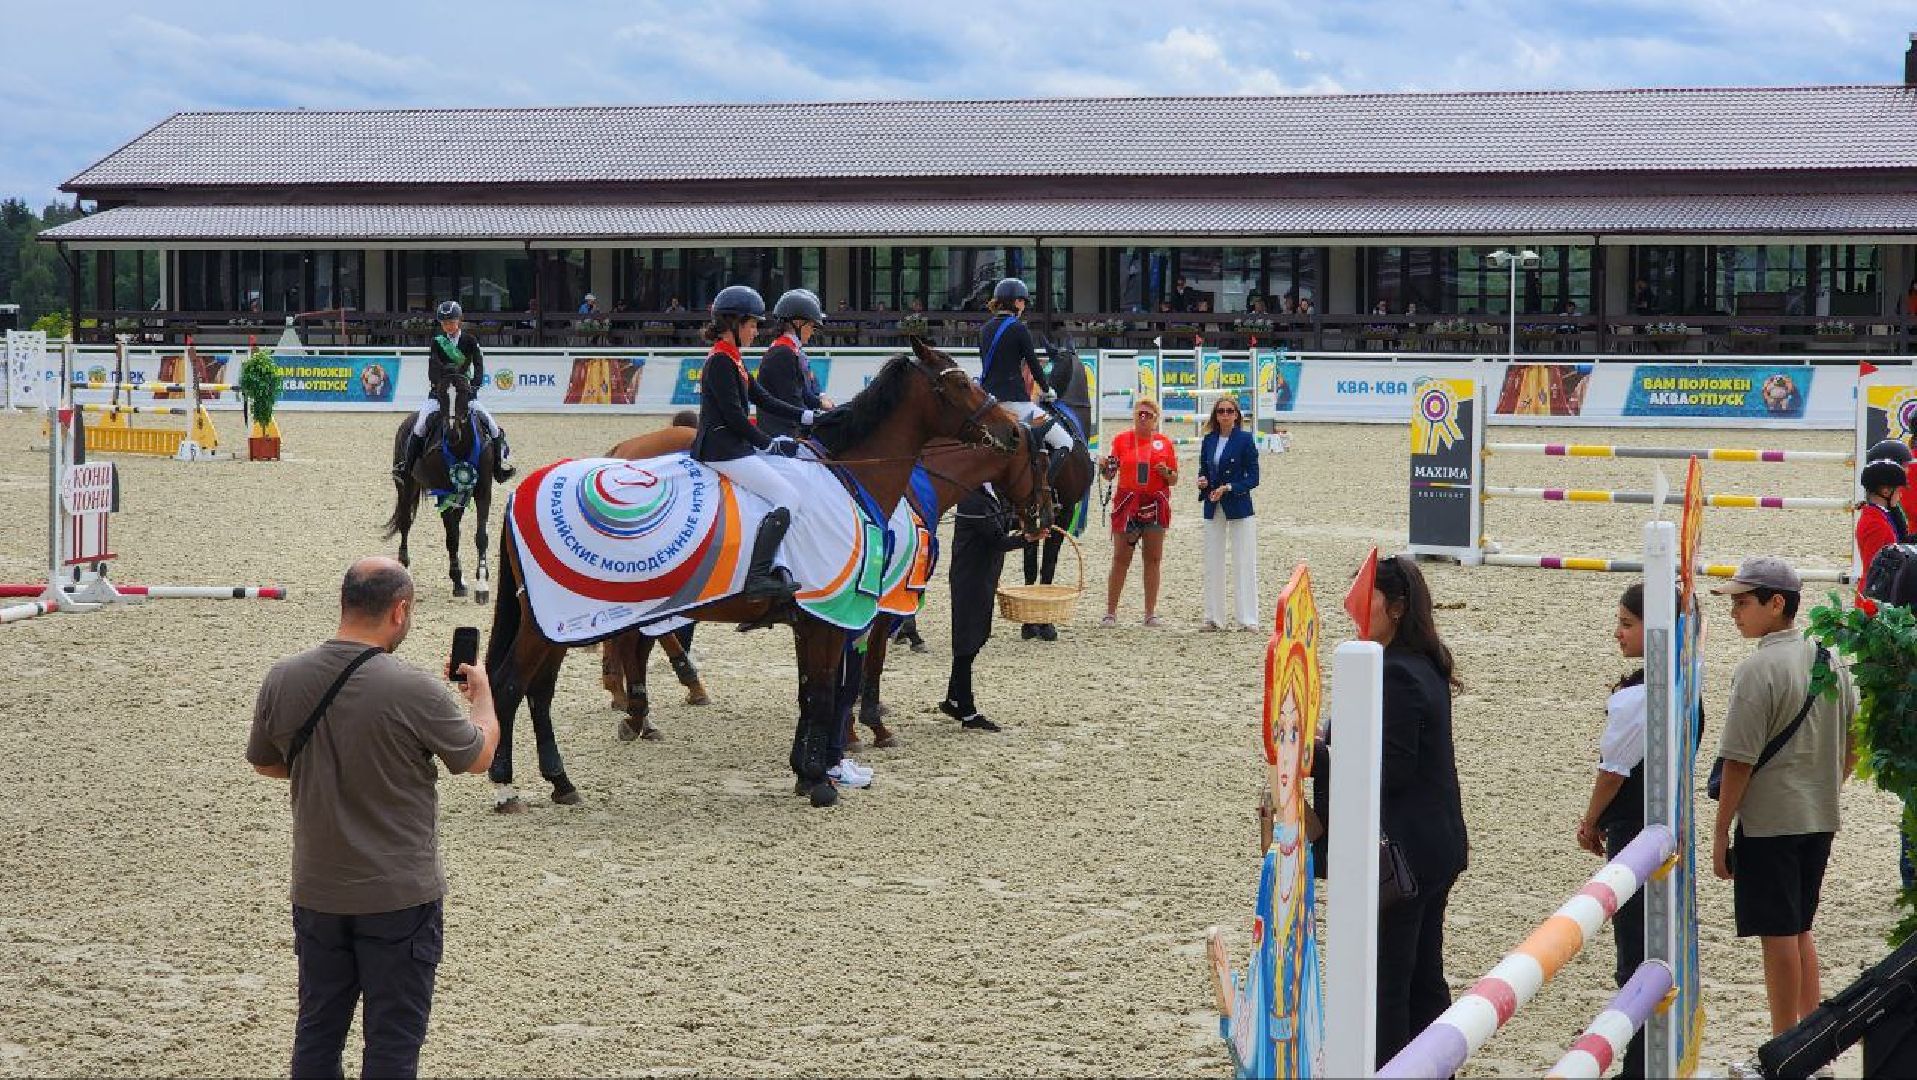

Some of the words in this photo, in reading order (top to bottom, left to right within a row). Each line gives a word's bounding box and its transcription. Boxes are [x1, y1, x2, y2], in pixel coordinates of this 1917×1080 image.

[295, 367, 352, 378] ПОЛОЖЕН
[518, 374, 555, 387] ПАРК
[1643, 377, 1676, 391] ВАМ
[1679, 377, 1751, 391] ПОЛОЖЕН
[1649, 392, 1745, 406] АКВАОТПУСК
[73, 466, 110, 489] КОНИ
[1414, 465, 1468, 480] MAXIMA
[550, 475, 600, 567] ЕВРАЗИЙСКИЕ
[600, 515, 699, 574] МОЛОДЁЖНЫЕ
[691, 482, 706, 513] ИГРЫ
